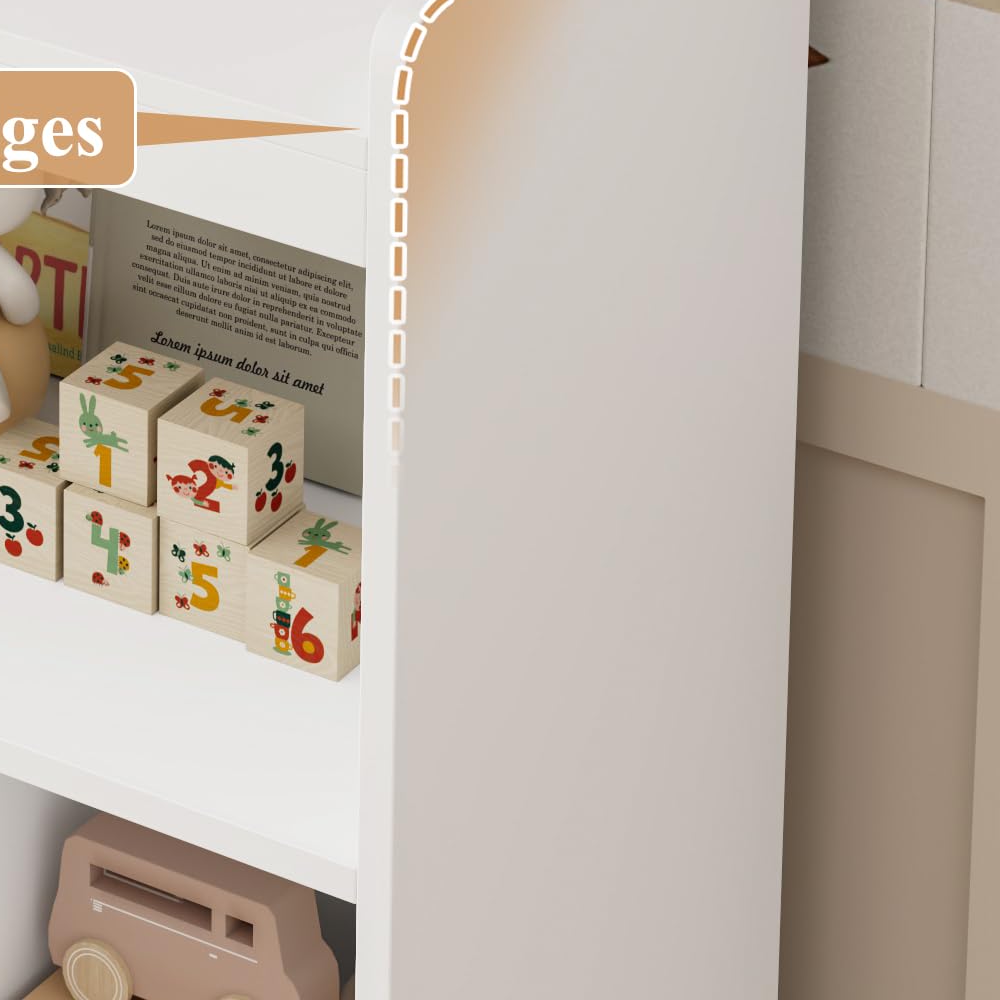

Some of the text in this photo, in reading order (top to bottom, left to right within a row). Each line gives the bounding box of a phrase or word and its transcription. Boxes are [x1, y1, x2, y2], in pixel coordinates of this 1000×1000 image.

[145, 220, 353, 291] Lorem ipsum dolor sit amet, consectetur adipiscing elit,
[145, 244, 351, 311] magna aliqua. Ut enim ad minim veniam, quis nostrud
[150, 234, 164, 243] sed
[164, 237, 175, 246] do
[175, 241, 207, 256] eiusmod
[208, 251, 236, 265] tempor
[237, 259, 276, 277] incididunt
[287, 274, 312, 288] labore
[322, 285, 347, 298] dolore
[130, 262, 362, 340] consequat. Duis aute irure dolor in reprehenderit in voluptate
[137, 274, 154, 284] velit
[155, 280, 171, 289] esse
[172, 284, 196, 298] cillum
[198, 292, 221, 305] dolore
[233, 302, 257, 316] fugiat
[258, 312, 278, 323] nulla
[279, 318, 313, 333] pariatur.
[315, 327, 355, 346] Excepteur
[139, 253, 183, 271] exercitation
[185, 267, 215, 281] ullamco
[216, 275, 242, 289] laboris
[243, 285, 258, 294] nisi
[269, 292, 297, 307] aliquip
[308, 305, 318, 313] ea
[319, 309, 356, 324] commodo
[131, 283, 359, 359] sint occaecat cupidatat non proident, sunt in culpa qui officia
[175, 308, 312, 355] deserunt mollit anim id est laborum.
[103, 364, 155, 391] 5
[150, 331, 325, 396] Lorem ipsum dolor sit amet
[200, 396, 253, 424] 5
[94, 444, 112, 488] 1
[187, 459, 221, 513] 2
[266, 442, 284, 491] 3
[91, 522, 119, 576] 4
[190, 561, 220, 612] 5
[291, 606, 325, 664] 6
